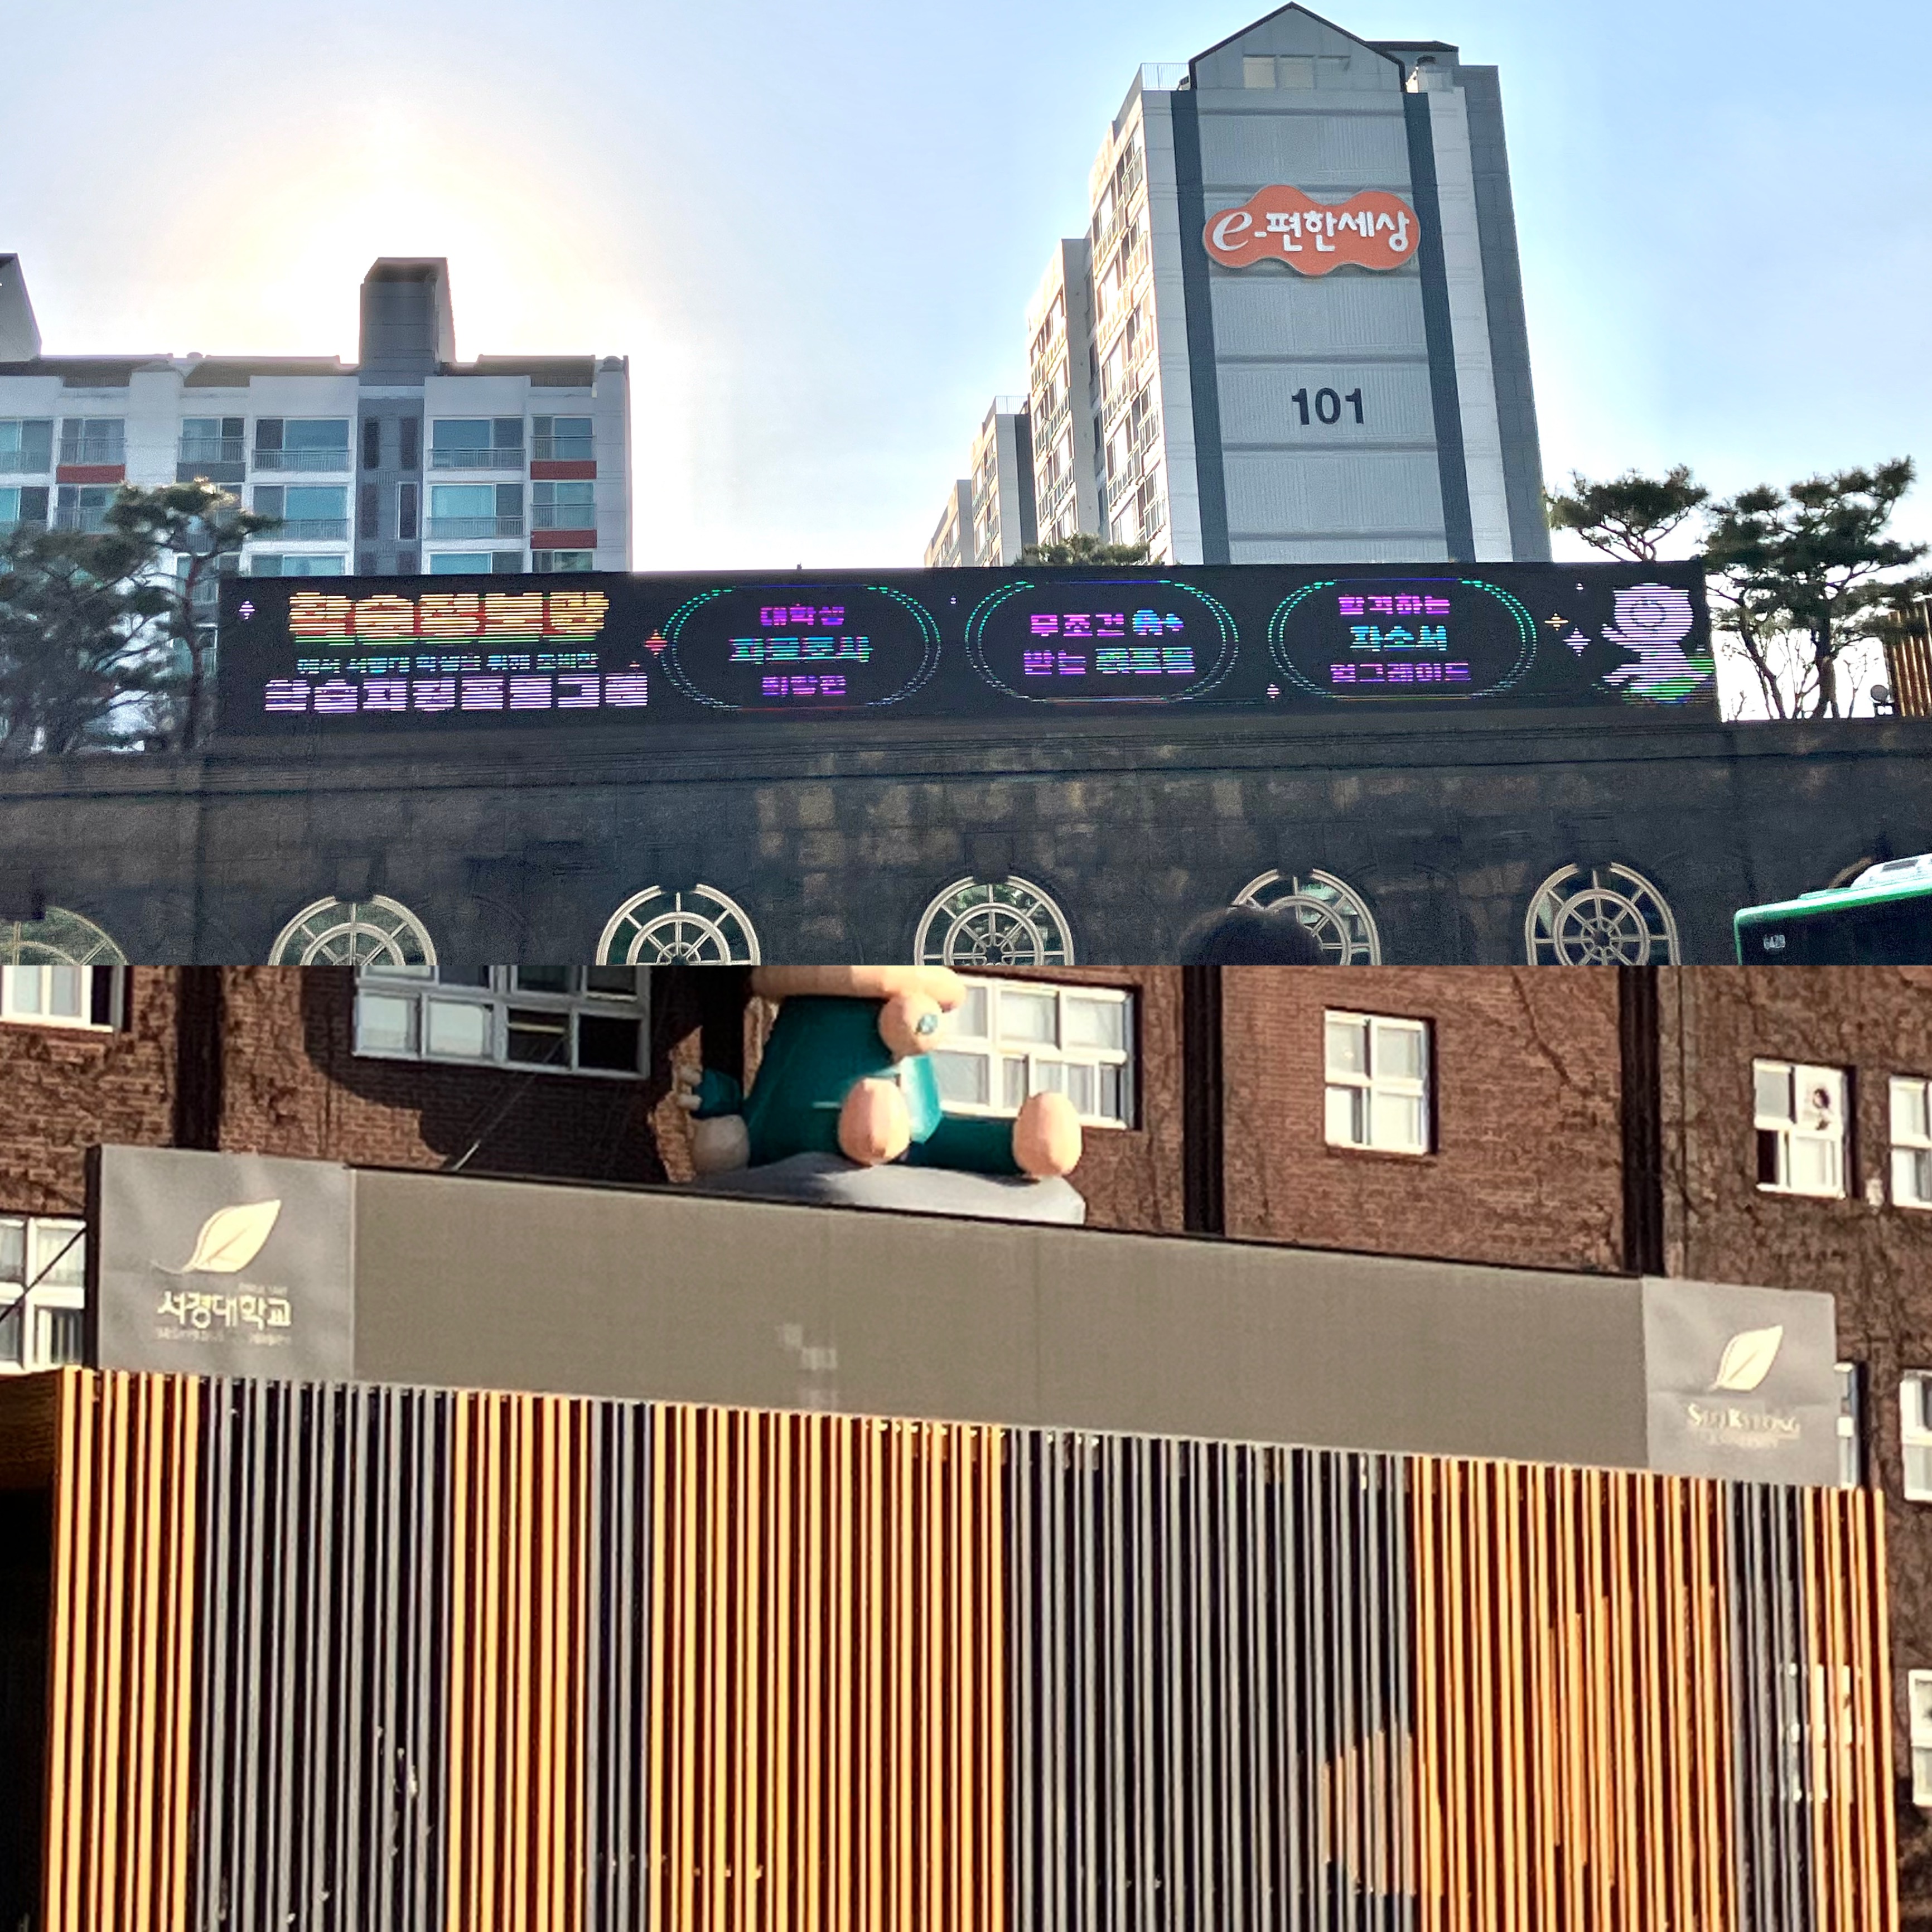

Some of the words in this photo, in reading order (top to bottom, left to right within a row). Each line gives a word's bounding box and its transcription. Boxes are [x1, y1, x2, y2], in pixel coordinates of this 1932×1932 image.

[1213, 211, 1409, 252] e-편한세상
[1292, 388, 1364, 426] 101
[760, 604, 844, 626] 대학생
[1338, 593, 1451, 615] 합격하는
[1030, 614, 1125, 636] 무조건
[1349, 625, 1447, 651] 자소서
[1023, 650, 1086, 675] 받는
[1330, 663, 1471, 683] 업그레이드
[157, 1291, 292, 1331] 서경대학교
